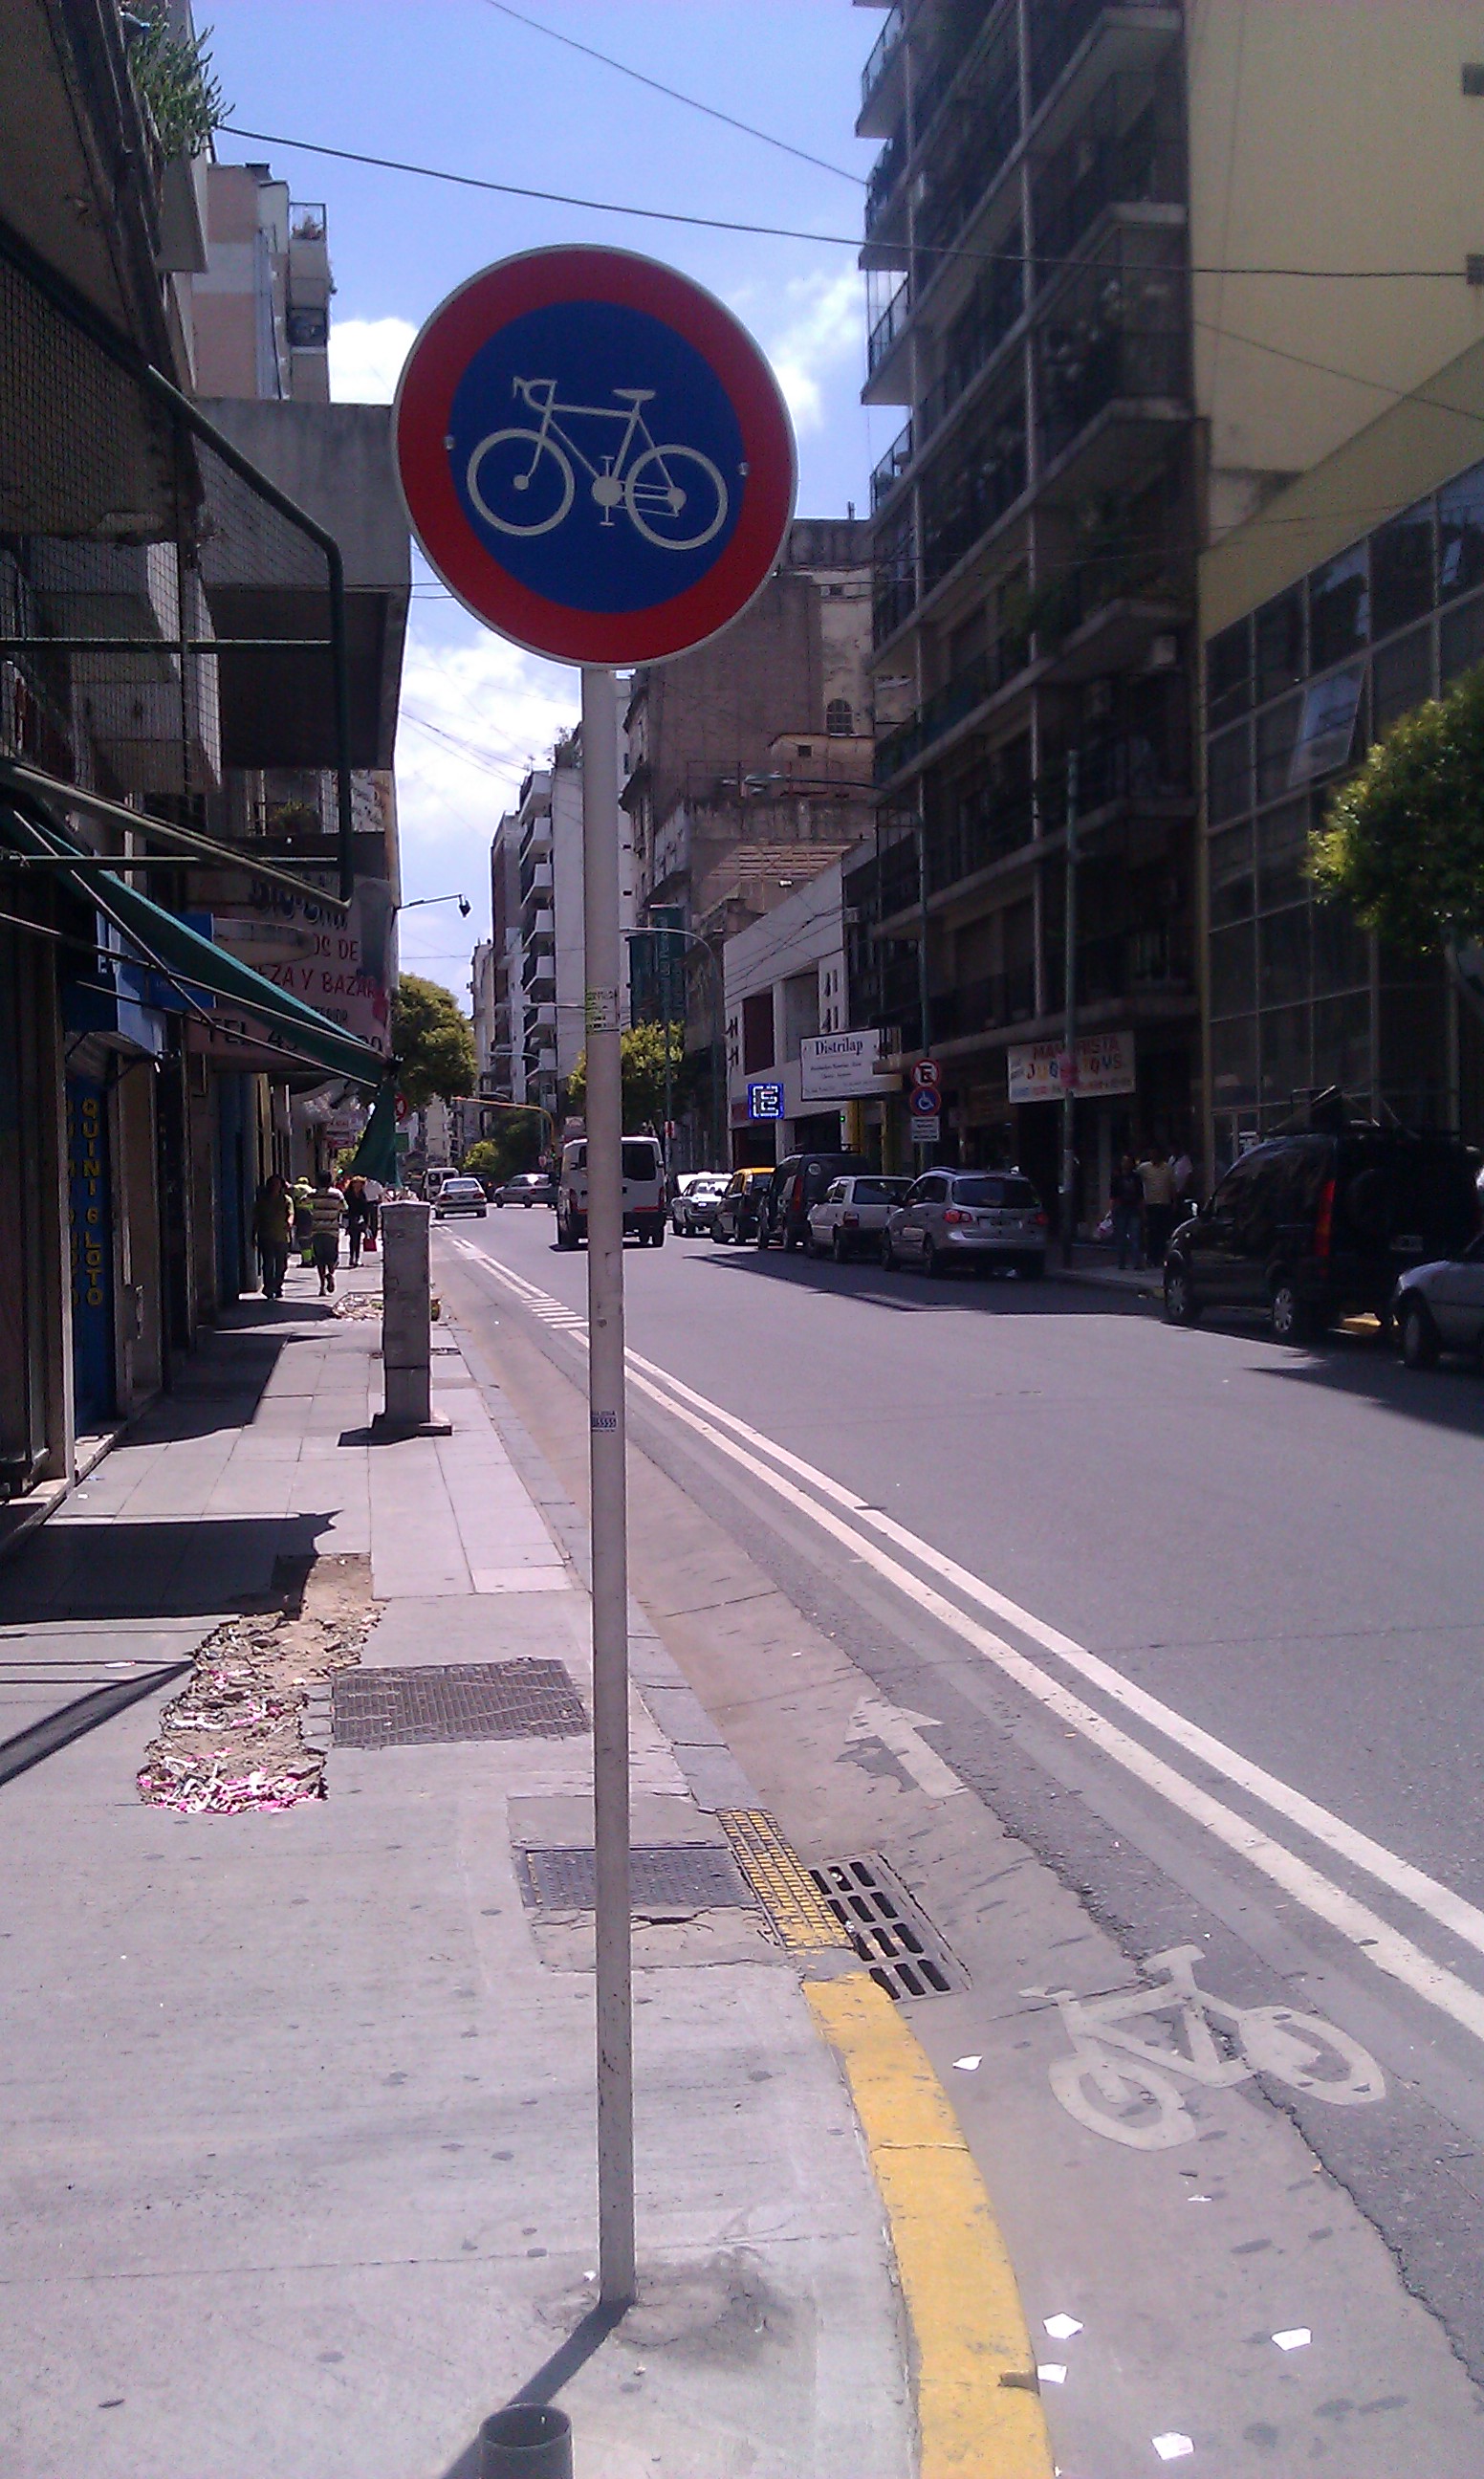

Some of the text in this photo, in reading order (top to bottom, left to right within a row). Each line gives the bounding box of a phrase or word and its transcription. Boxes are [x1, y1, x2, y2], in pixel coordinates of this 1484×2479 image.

[338, 939, 358, 960] DE
[302, 968, 314, 990] Y
[322, 972, 377, 998] BAZAR
[815, 1037, 863, 1056] Distrilap
[82, 1097, 103, 1306] QUINI 6 LOTO
